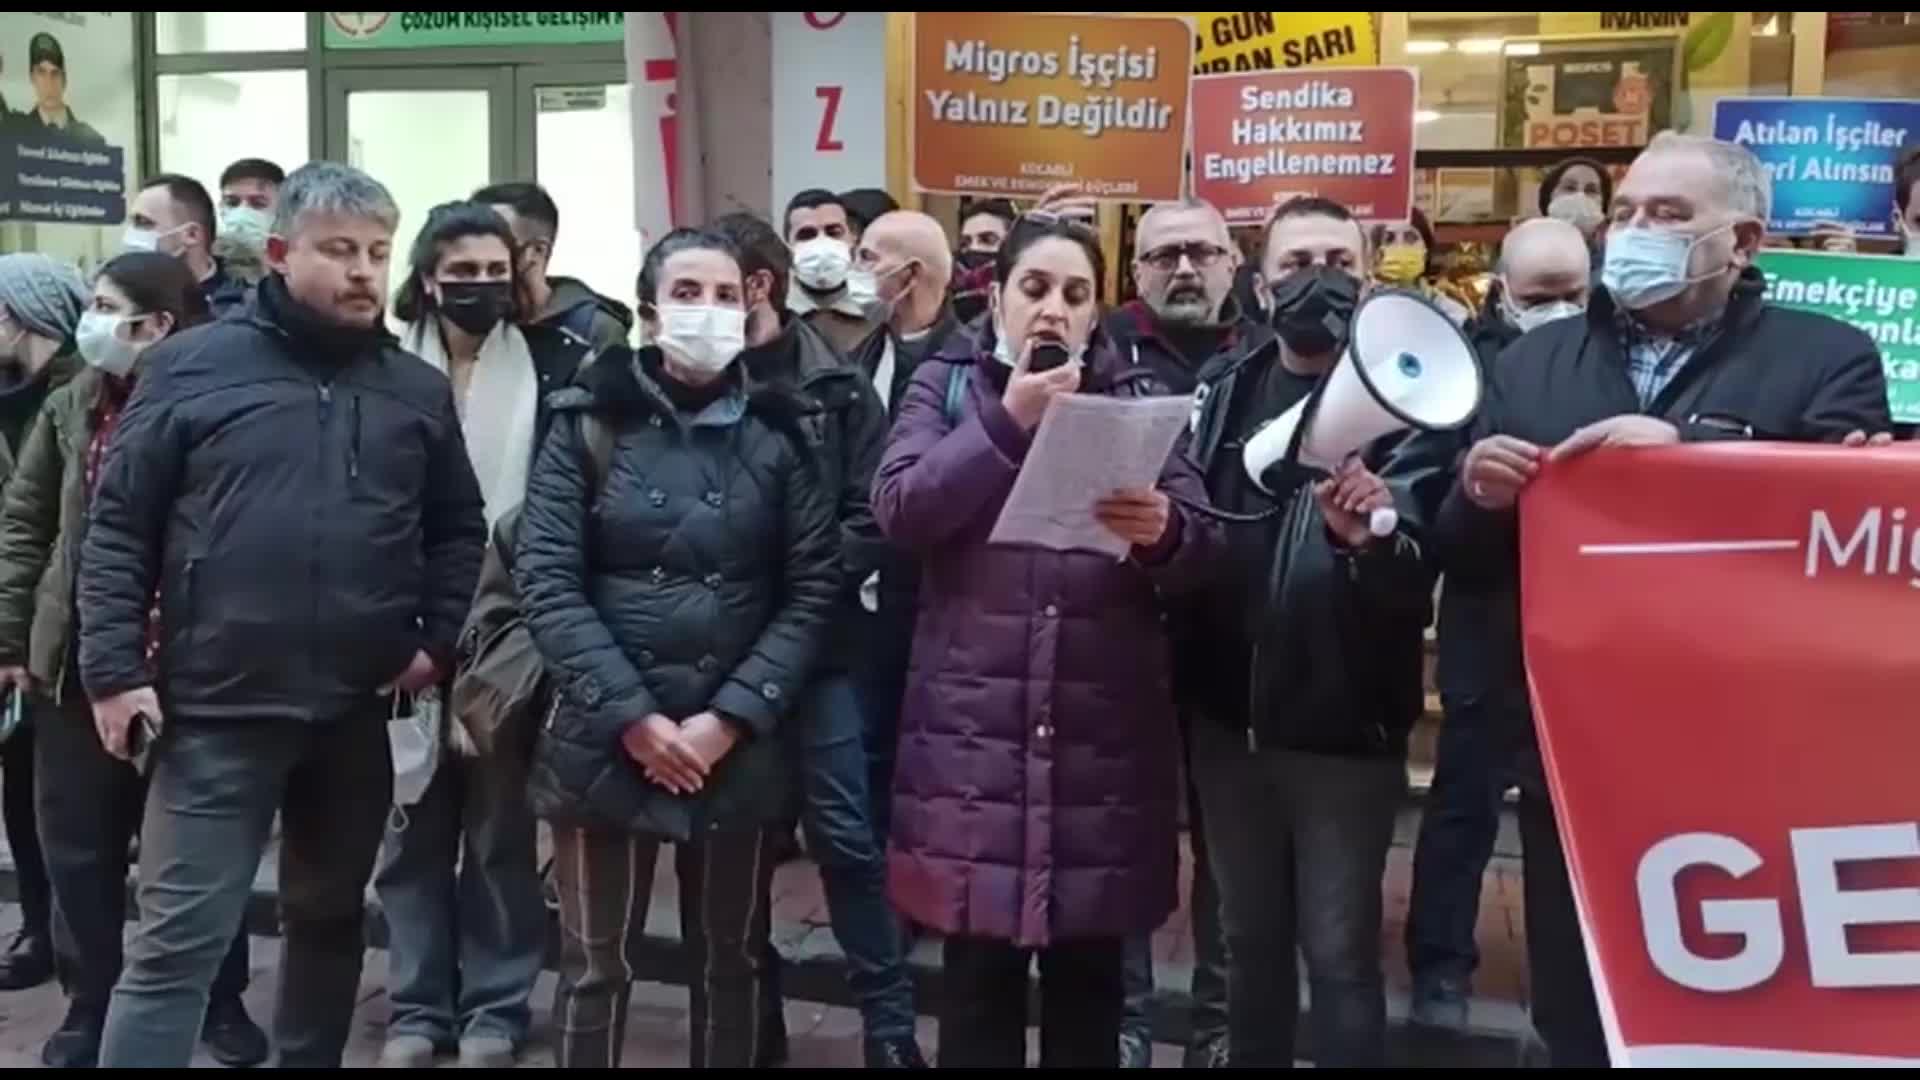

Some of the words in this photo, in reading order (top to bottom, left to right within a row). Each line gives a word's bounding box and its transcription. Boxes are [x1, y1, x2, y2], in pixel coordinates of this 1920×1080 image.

[944, 39, 1059, 82] Migros
[1068, 33, 1158, 87] İşçisi
[1283, 25, 1356, 67] SARI
[924, 89, 1029, 124] Yalnız
[1036, 94, 1173, 136] Değildir
[1240, 80, 1353, 110] Sendika
[1232, 115, 1363, 145] Hakkımız
[1733, 119, 1819, 145] Atılan
[1826, 112, 1908, 152] İşçiler
[1204, 150, 1395, 184] Engellenemez
[1801, 155, 1894, 183] Alınsın
[1762, 272, 1919, 316] Emekçiye
[1805, 507, 1920, 589] Mi
